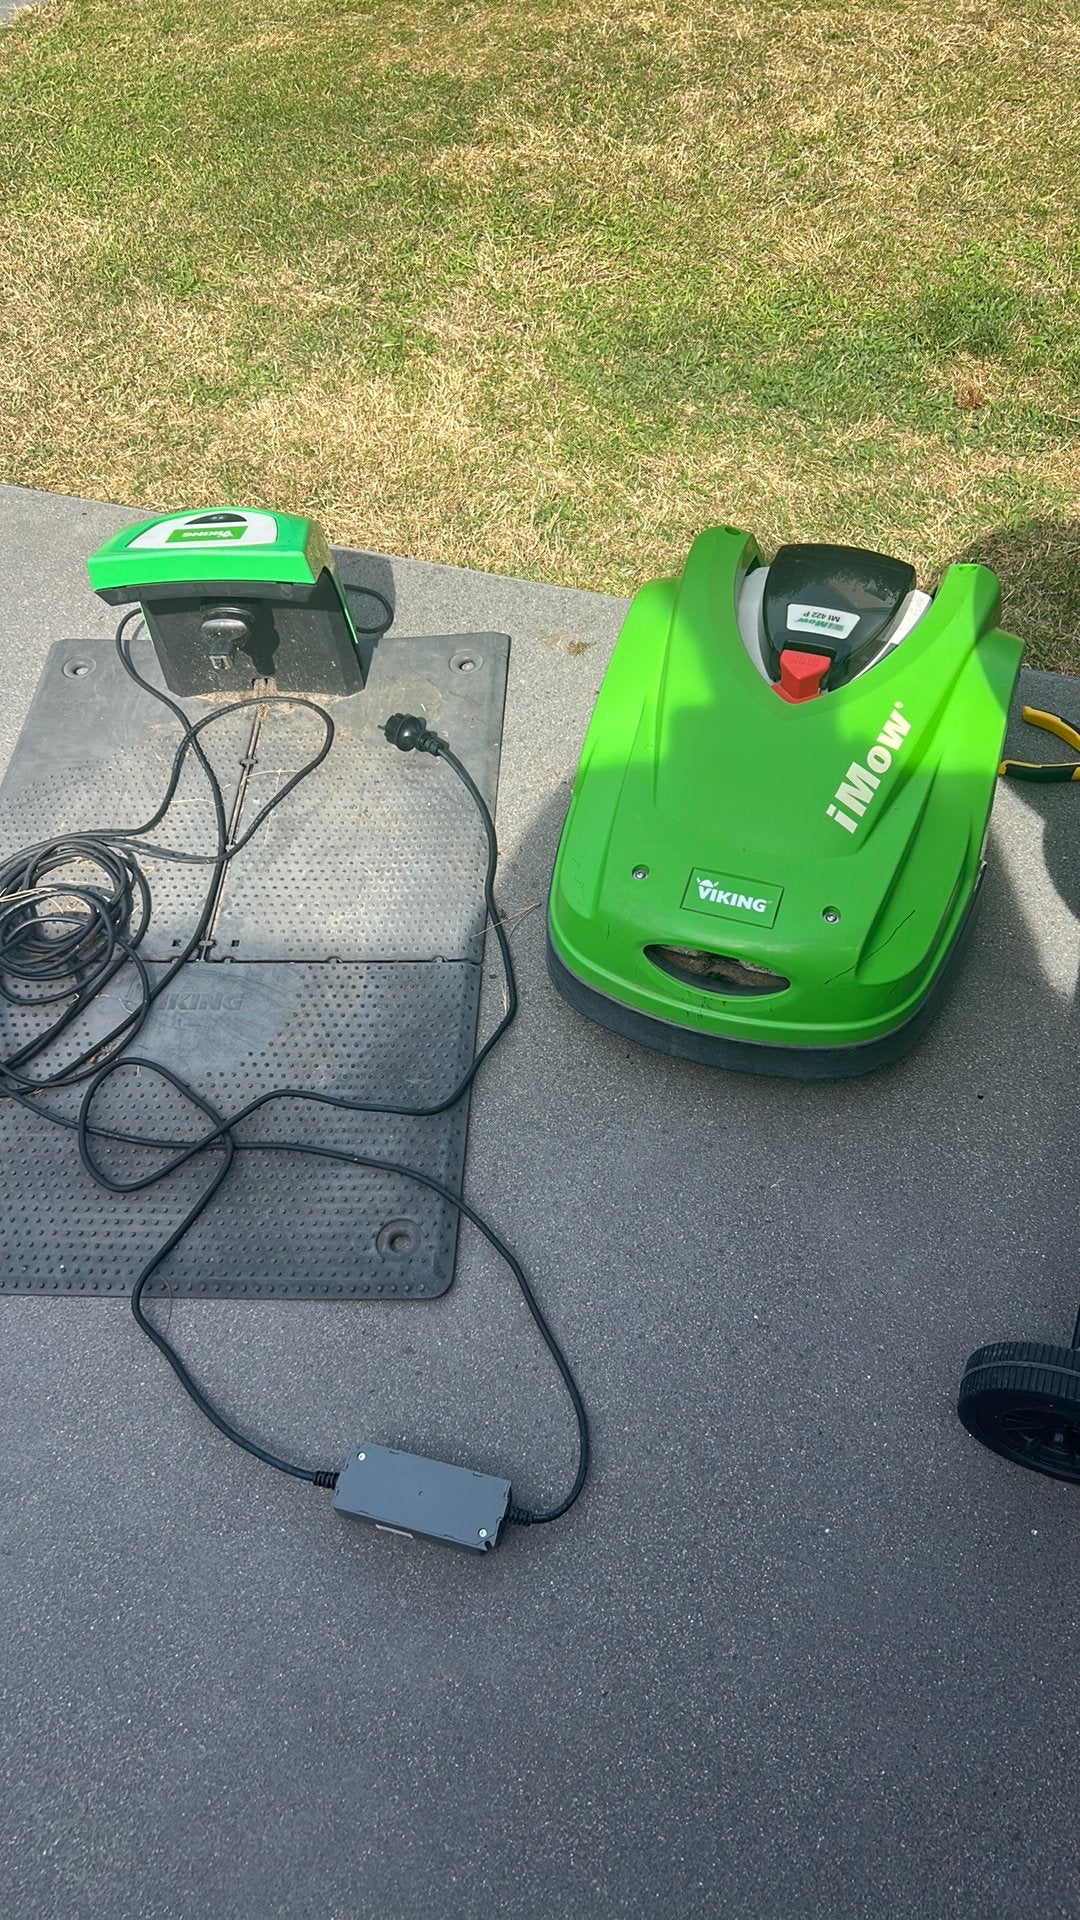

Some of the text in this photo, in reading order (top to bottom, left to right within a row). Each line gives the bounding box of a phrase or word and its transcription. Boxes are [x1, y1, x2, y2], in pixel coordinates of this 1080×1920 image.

[181, 530, 234, 540] VIKING
[802, 610, 841, 623] MI 422 P
[697, 886, 768, 913] VIKING
[153, 992, 244, 1011] IKING
